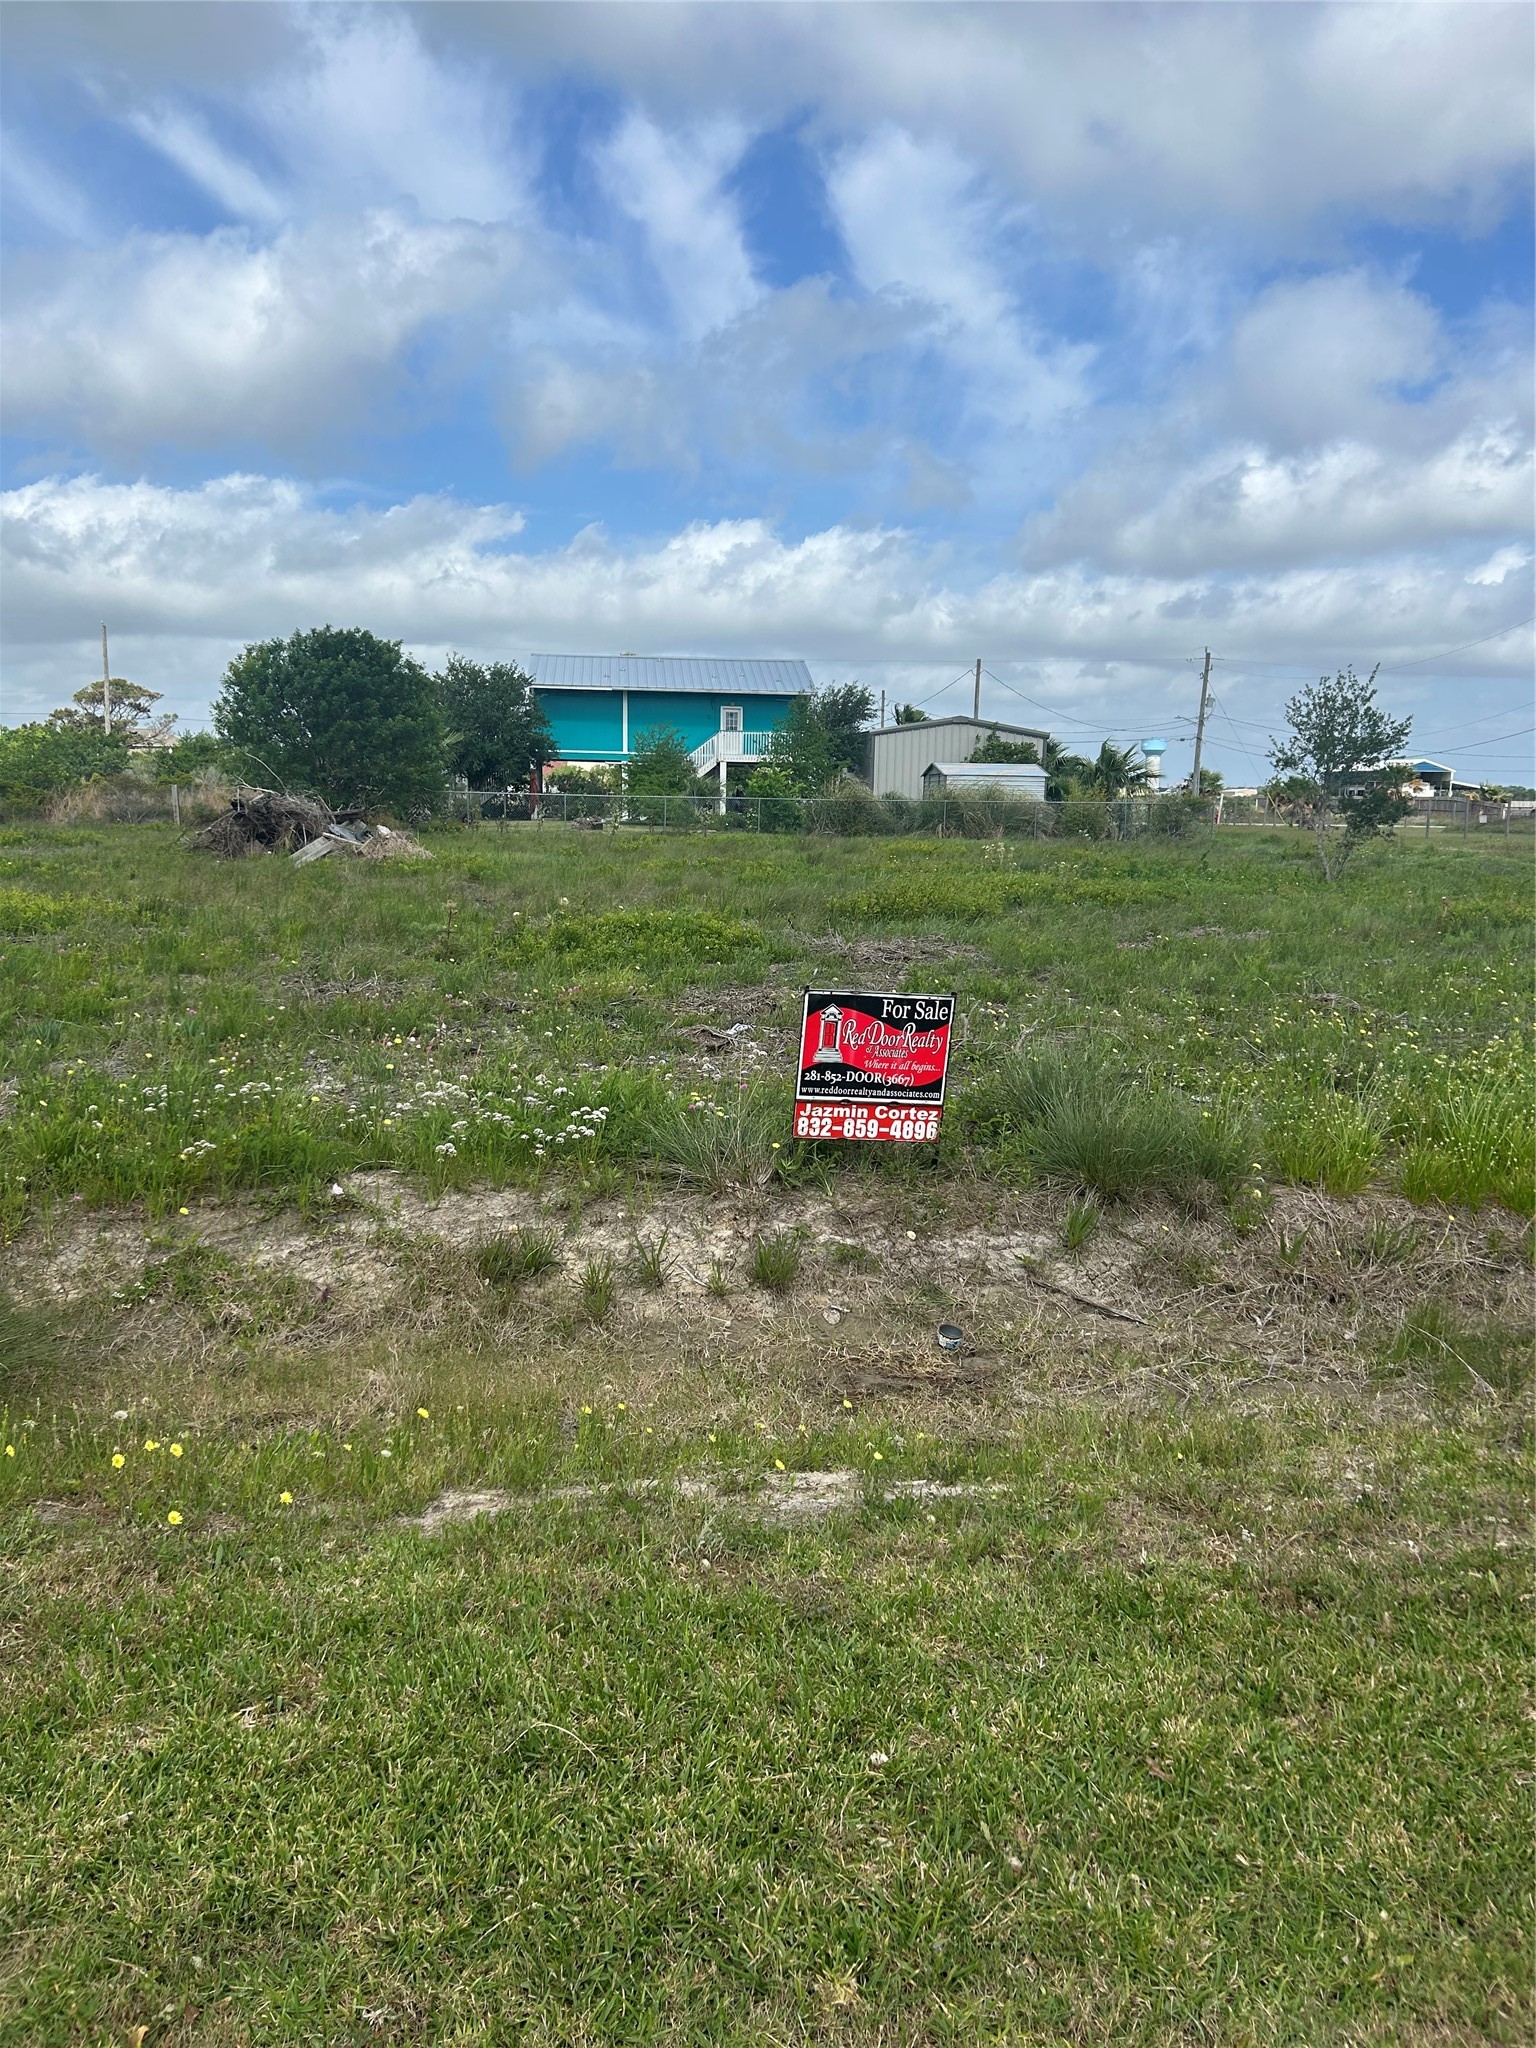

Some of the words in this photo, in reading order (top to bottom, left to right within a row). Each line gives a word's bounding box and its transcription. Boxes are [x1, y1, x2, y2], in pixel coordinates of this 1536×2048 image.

[881, 999, 911, 1018] For
[914, 1001, 948, 1020] Sale
[872, 1045, 908, 1058] Associates
[864, 1059, 889, 1069] Where
[891, 1061, 897, 1069] it
[899, 1061, 910, 1070] all
[801, 1086, 939, 1098] www.reddoorrealtyandassociates.com
[800, 1104, 868, 1118] Jazmin
[875, 1106, 938, 1120] Cortez
[797, 1117, 937, 1140] 832-859-4896
